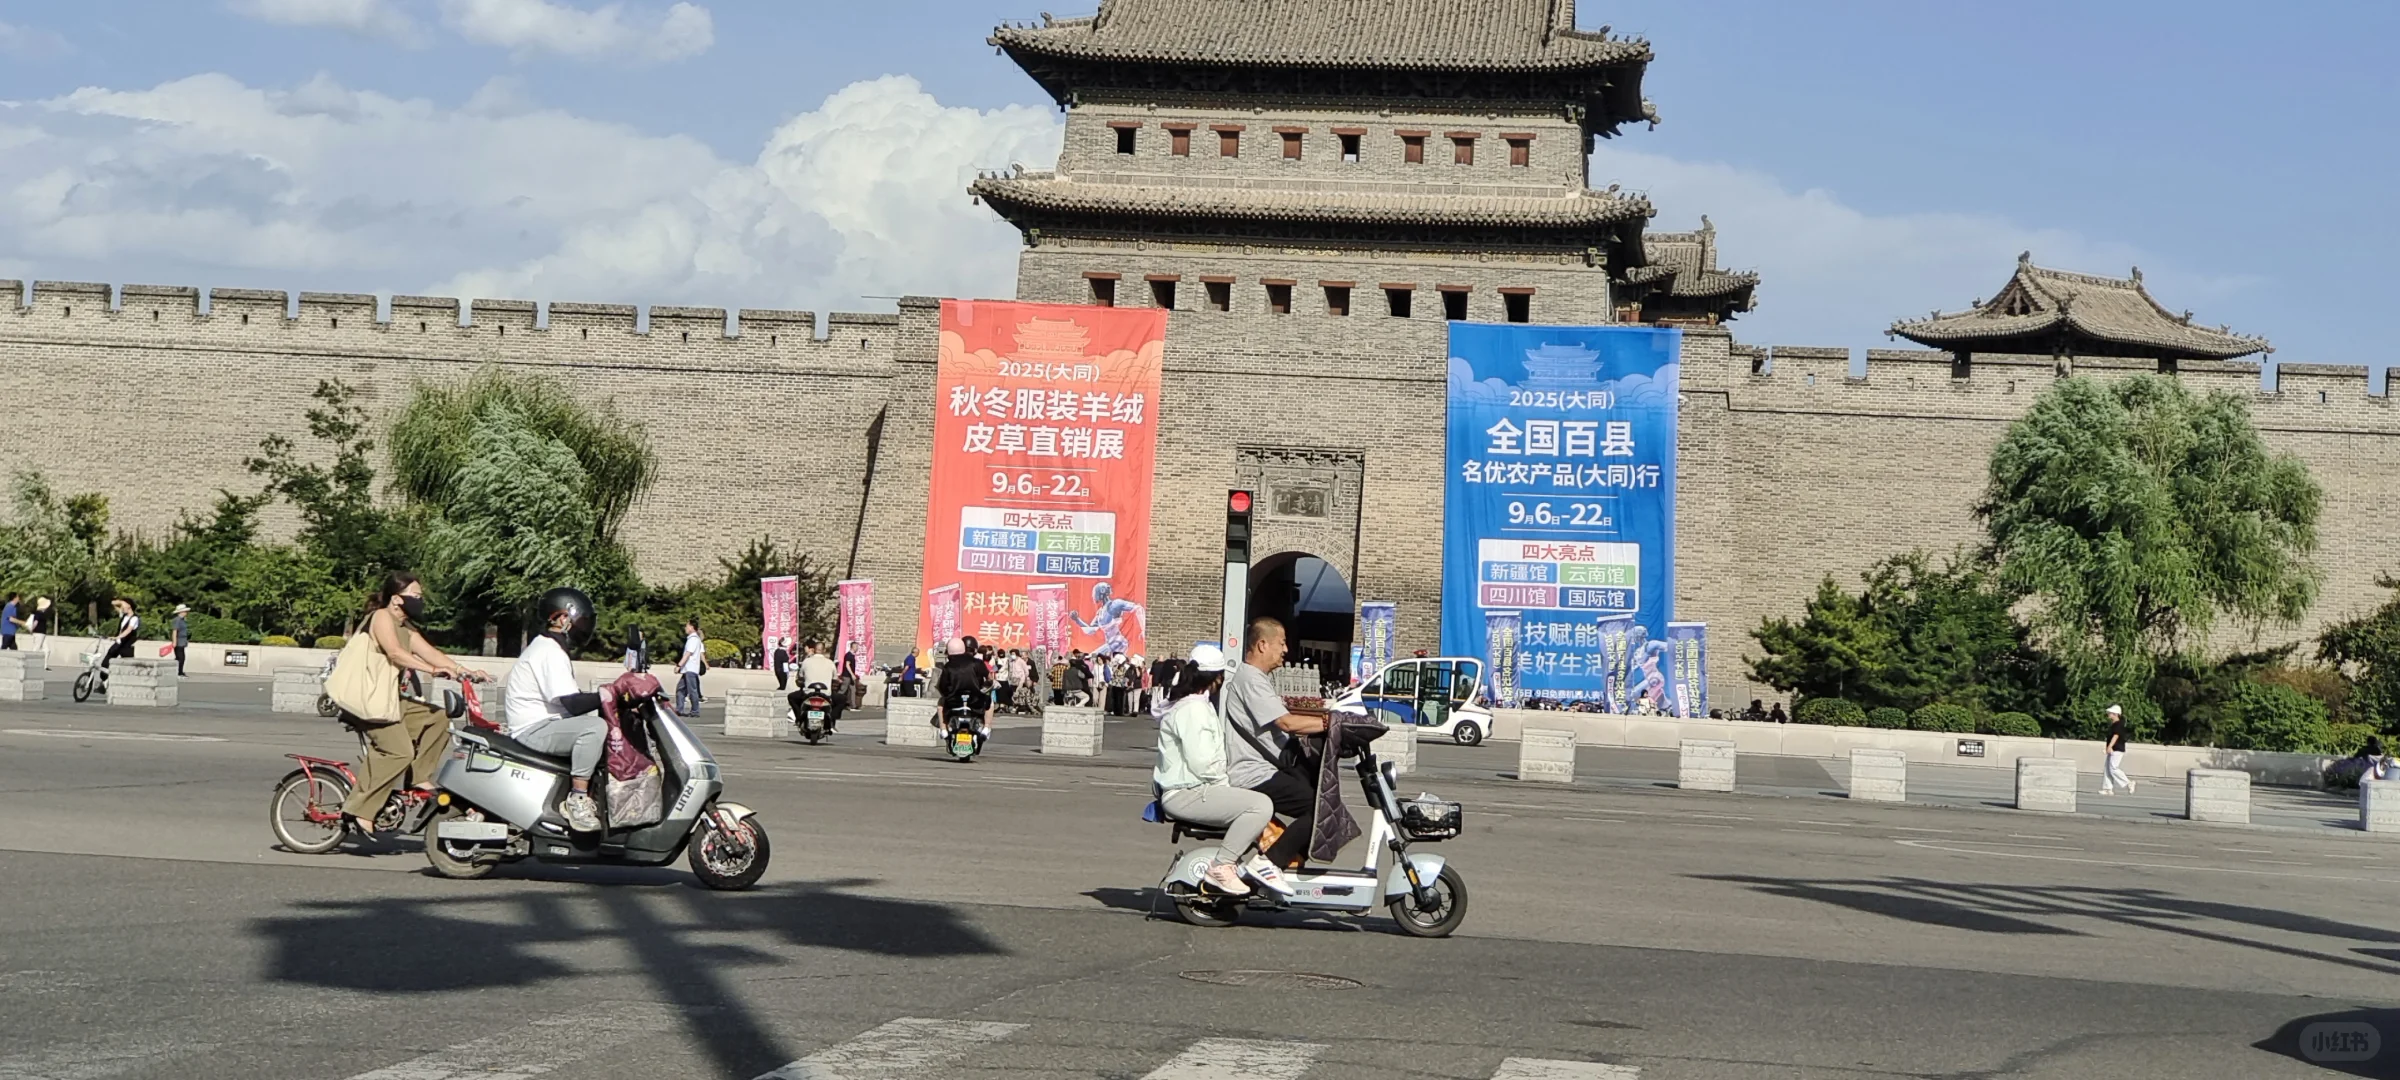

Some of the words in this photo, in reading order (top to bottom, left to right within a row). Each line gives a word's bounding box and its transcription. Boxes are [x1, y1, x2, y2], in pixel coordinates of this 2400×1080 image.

[998, 361, 1100, 382] 2025(大同)
[949, 385, 1144, 424] 秋冬服装羊绒
[1509, 391, 1616, 410] 2025(大同)
[962, 421, 1125, 460] 皮草直销展
[1486, 418, 1635, 457] 全国百县
[992, 472, 1089, 497] 9月6日-22日
[1462, 460, 1660, 490] 名优农产品(大同)行
[1003, 512, 1073, 530] 四大亮点
[1508, 501, 1612, 527] 9月6日-22日
[972, 529, 1027, 548] 新疆馆
[1046, 534, 1100, 551] 云南馆
[970, 553, 1026, 571] 四川馆
[1522, 544, 1595, 562] 四大亮点
[1045, 556, 1100, 573] 国际馆
[1490, 563, 1548, 582] 新疆馆
[1567, 566, 1625, 583] 云南馆
[1489, 587, 1547, 605] 四川馆
[1568, 589, 1625, 607] 国际馆
[1518, 621, 1598, 648] 技赋能
